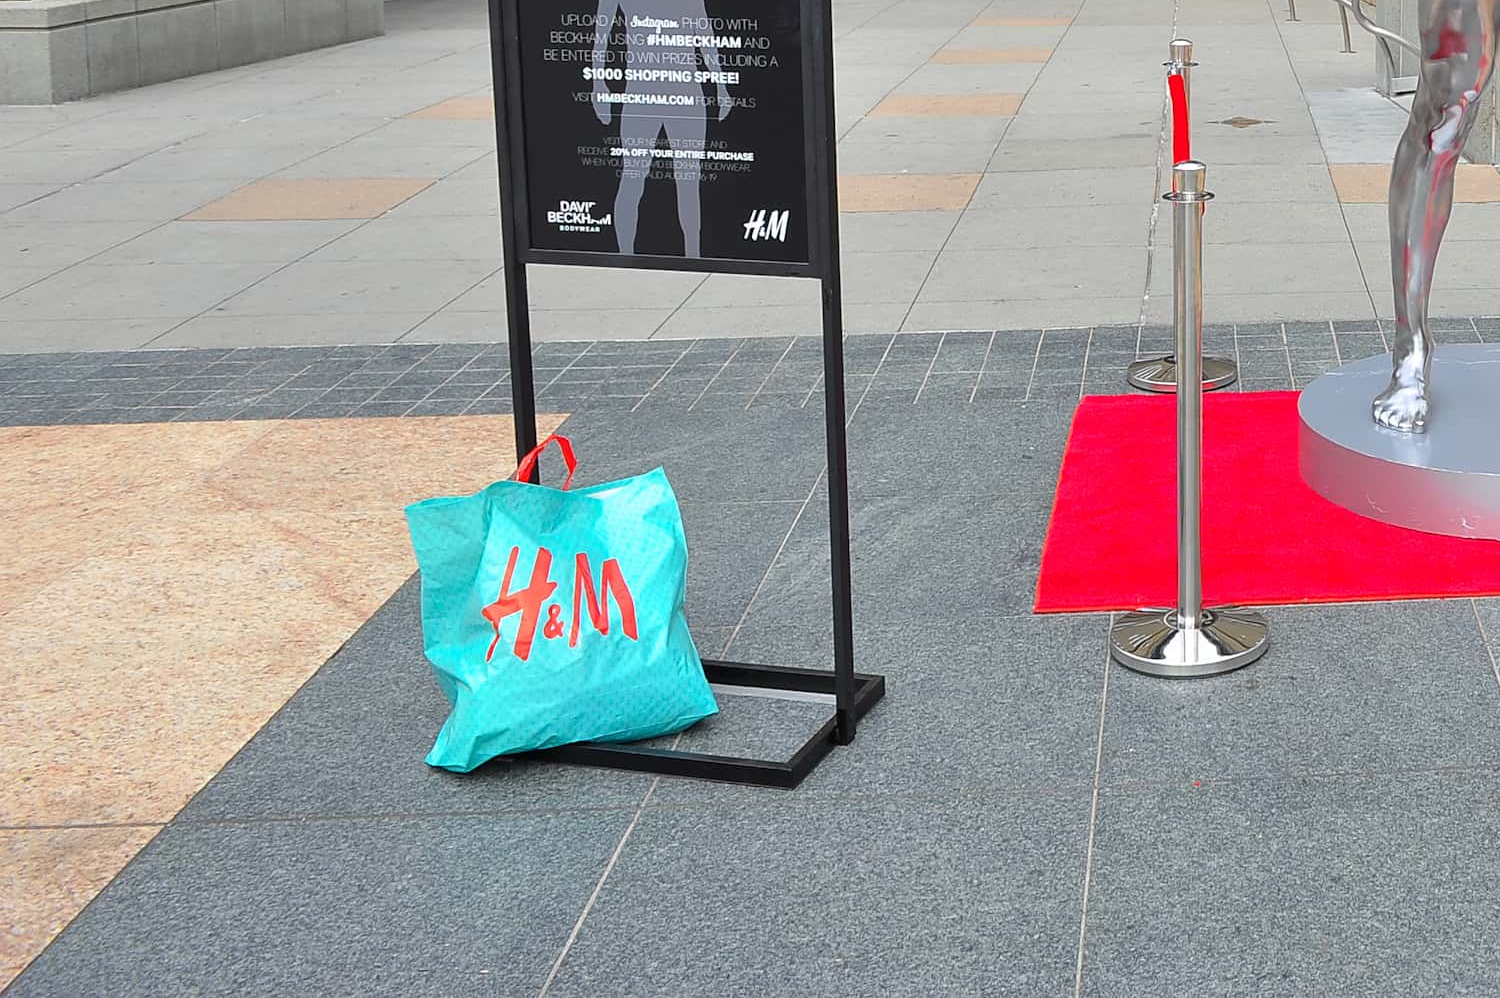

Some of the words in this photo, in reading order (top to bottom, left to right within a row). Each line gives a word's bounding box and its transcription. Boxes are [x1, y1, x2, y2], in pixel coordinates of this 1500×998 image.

[561, 14, 608, 27] UPLOAD
[611, 15, 627, 27] AN
[630, 15, 680, 34] Instagram
[681, 17, 723, 30] PHOTO
[726, 18, 758, 31] WITH
[550, 31, 607, 44] BECKHAM
[609, 33, 644, 45] USING
[647, 34, 741, 49] #HMBECKHAM
[743, 37, 770, 50] AND
[543, 49, 559, 61] BE
[561, 49, 616, 63] ENTERED
[619, 51, 634, 64] TO
[636, 52, 660, 64] WIN
[662, 53, 703, 66] PRIZES
[704, 54, 767, 67] INCLUDING
[769, 55, 779, 67] A
[582, 67, 623, 81] $1000
[624, 69, 692, 83] SHOPPING
[694, 71, 740, 85] SPREE!
[572, 92, 596, 103] VISIT
[596, 93, 694, 107] HMBECKHAM.COM
[695, 96, 717, 107] FOR
[717, 96, 757, 108] DETAILS
[610, 147, 630, 157] 20%
[631, 148, 649, 158] OFF
[649, 149, 673, 159] YOUR
[674, 150, 706, 160] ENTIRE
[707, 151, 755, 162] PURCHASE
[560, 200, 597, 213] DAVI
[743, 209, 790, 243] H&M
[481, 545, 639, 663] H&M
